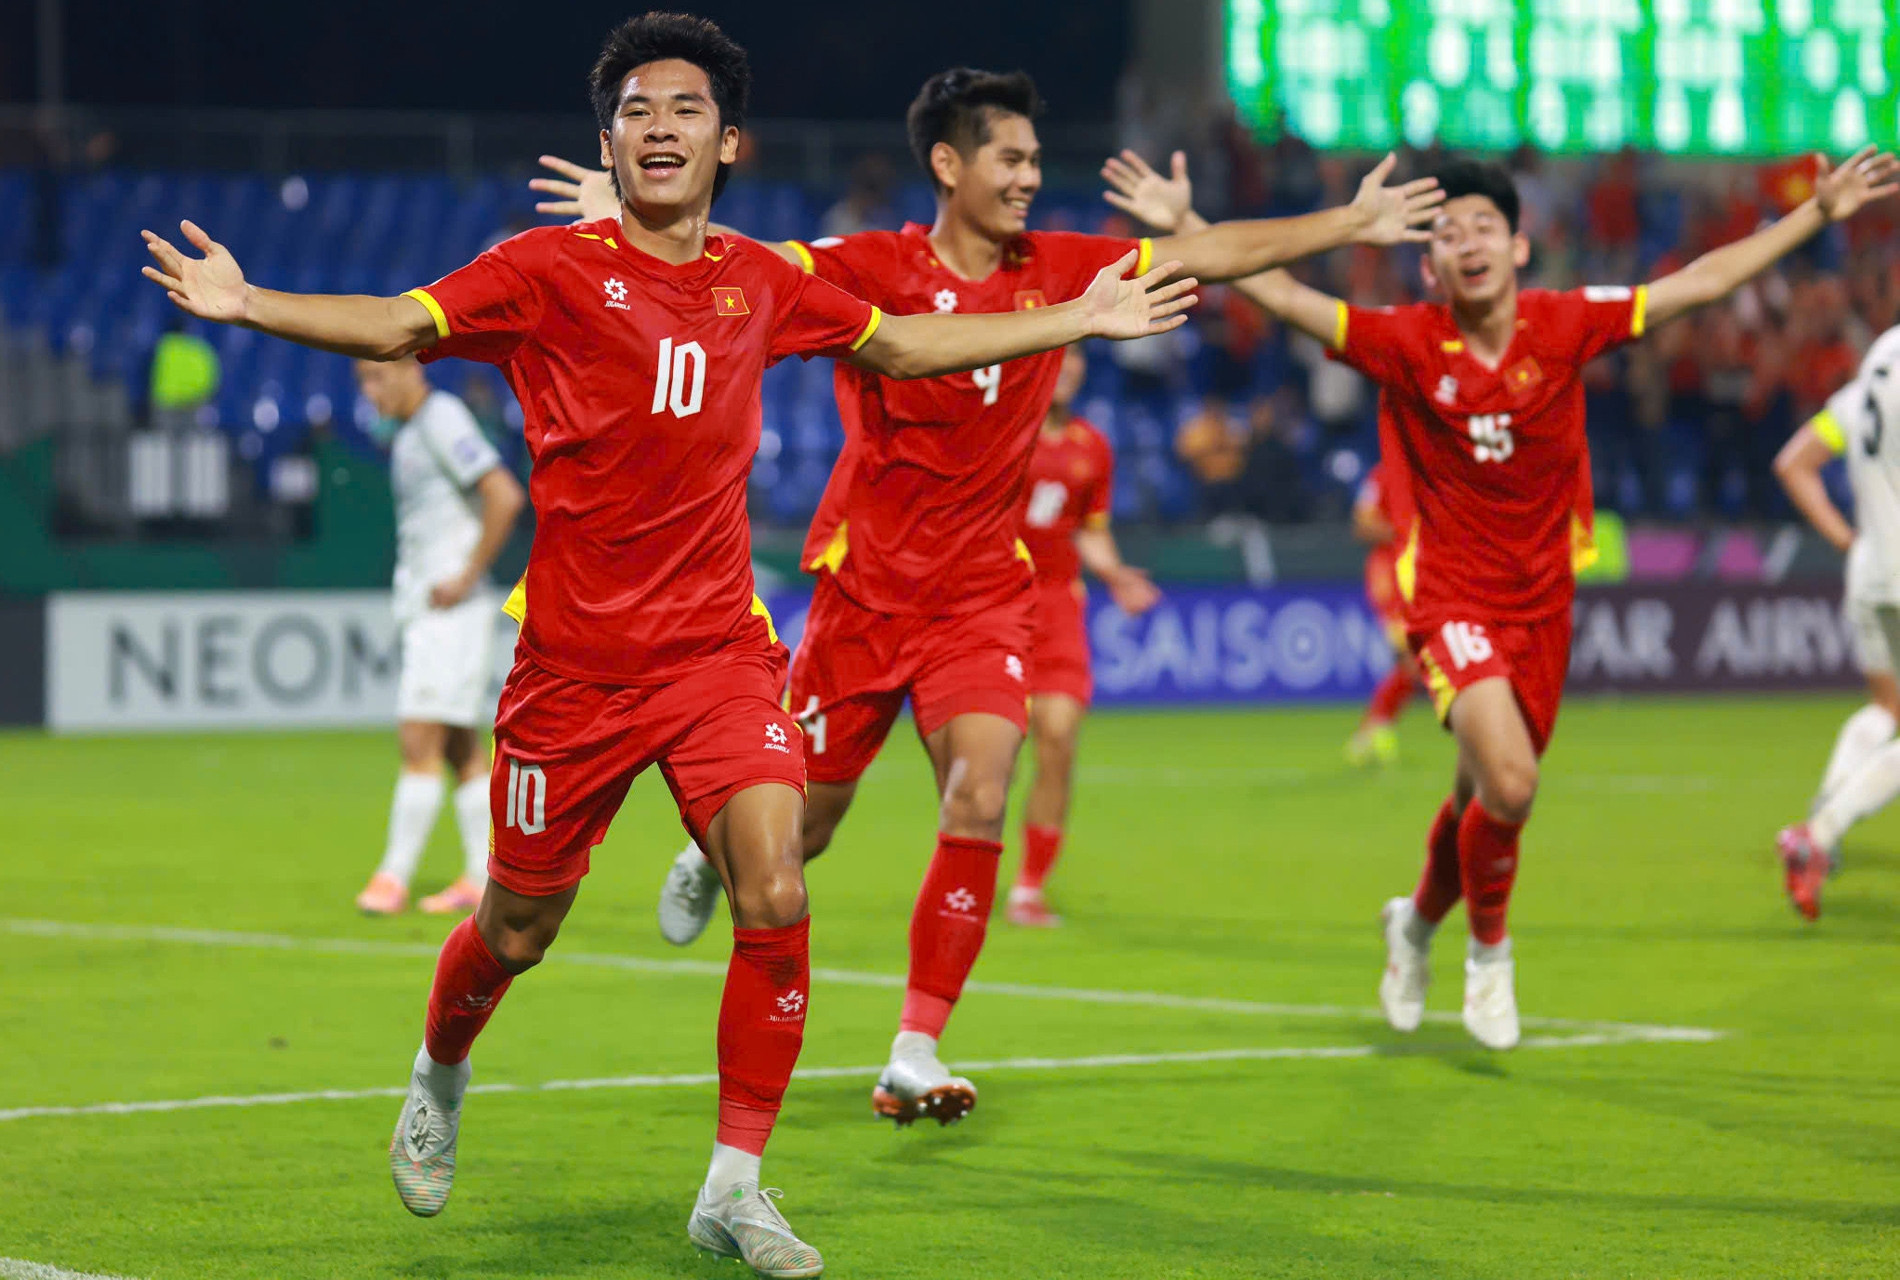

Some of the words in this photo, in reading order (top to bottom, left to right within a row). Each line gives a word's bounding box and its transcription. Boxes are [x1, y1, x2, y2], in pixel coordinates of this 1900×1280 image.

[651, 336, 706, 418] 10
[107, 612, 402, 705] NEOM
[1442, 620, 1494, 672] 16
[506, 757, 547, 836] 10
